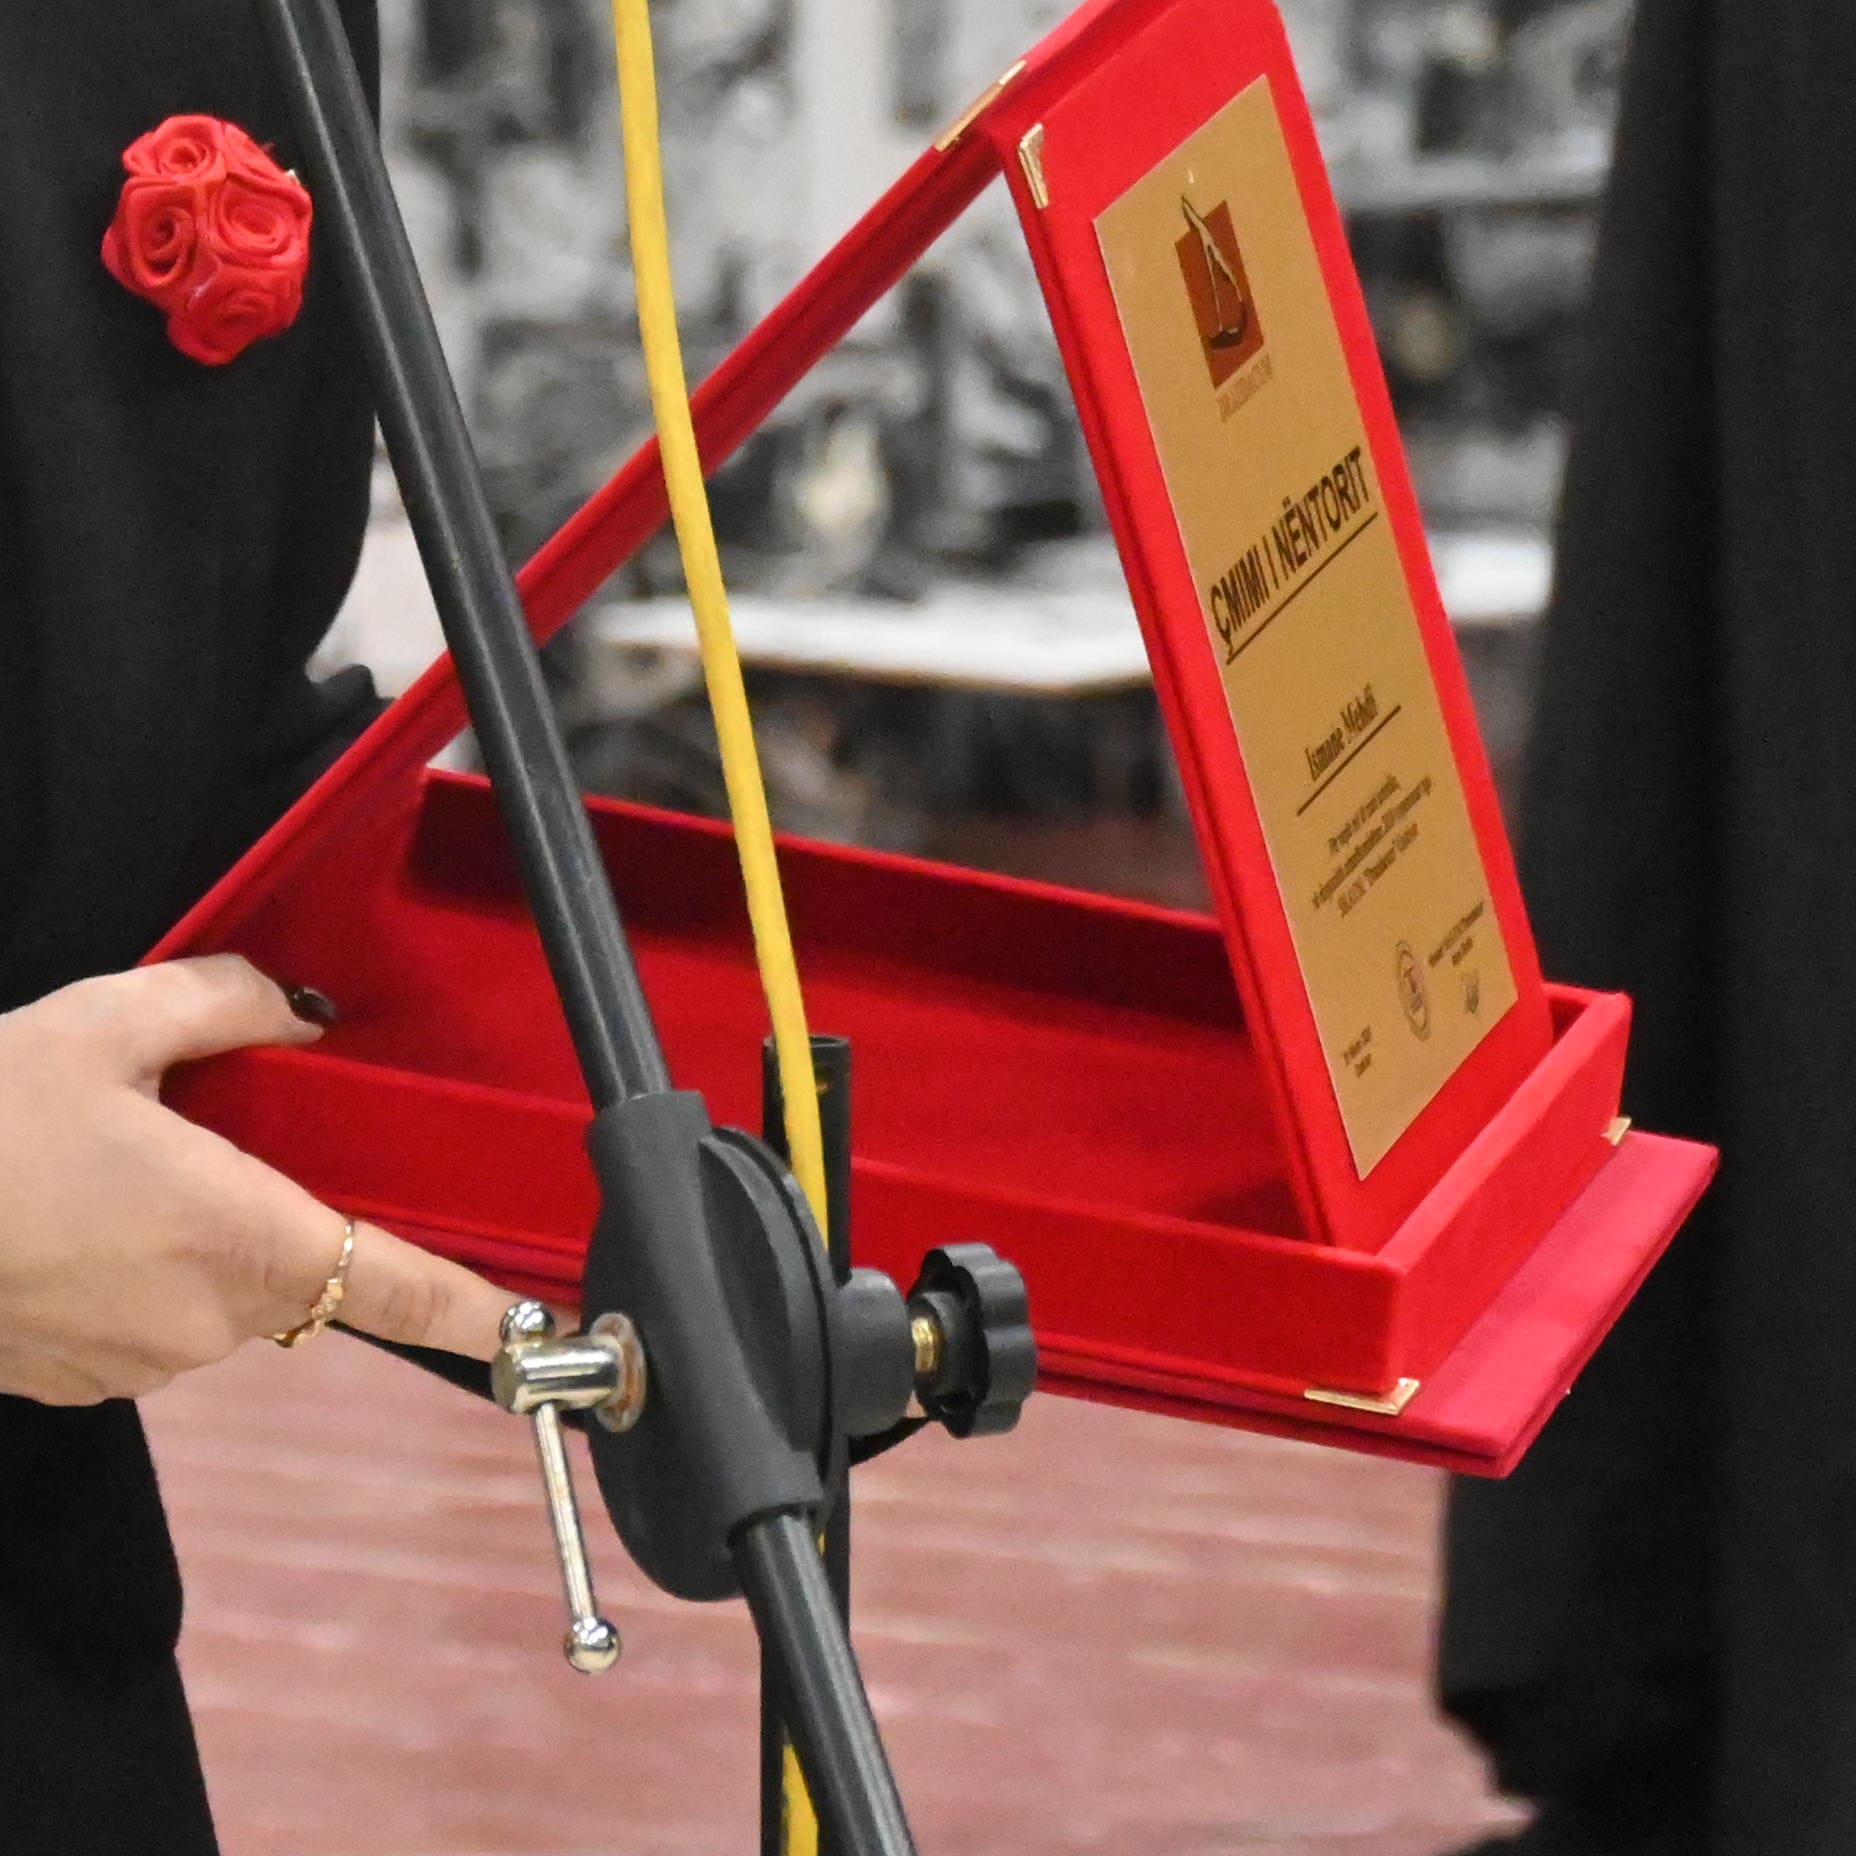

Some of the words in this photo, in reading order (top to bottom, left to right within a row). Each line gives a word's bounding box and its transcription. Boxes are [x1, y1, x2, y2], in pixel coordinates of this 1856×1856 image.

[1209, 543, 1270, 658] ÇMIMI
[1261, 534, 1280, 591] I
[1271, 445, 1370, 582] NËNTORIT
